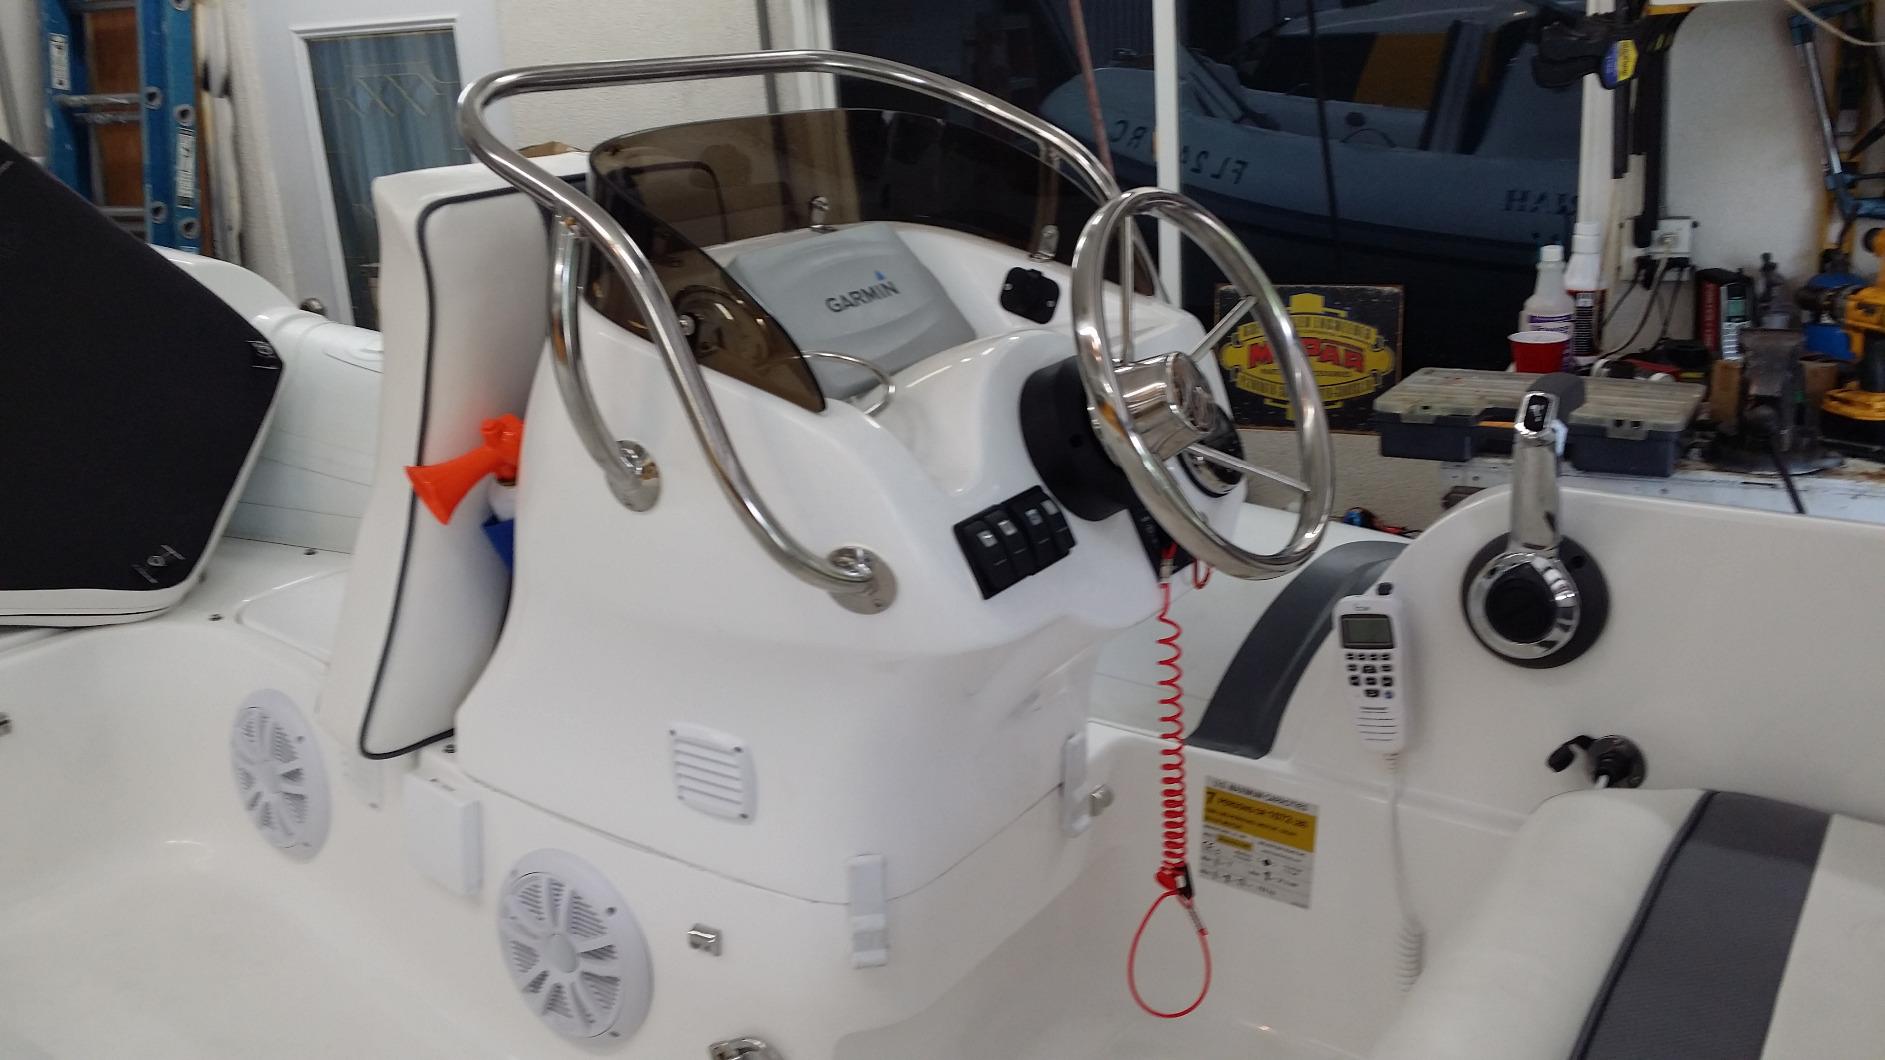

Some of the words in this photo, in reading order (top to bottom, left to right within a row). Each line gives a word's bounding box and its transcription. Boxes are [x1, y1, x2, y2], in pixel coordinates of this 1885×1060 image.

[824, 281, 899, 313] GARMIN
[1248, 336, 1365, 373] MPAR
[1206, 791, 1217, 804] 7
